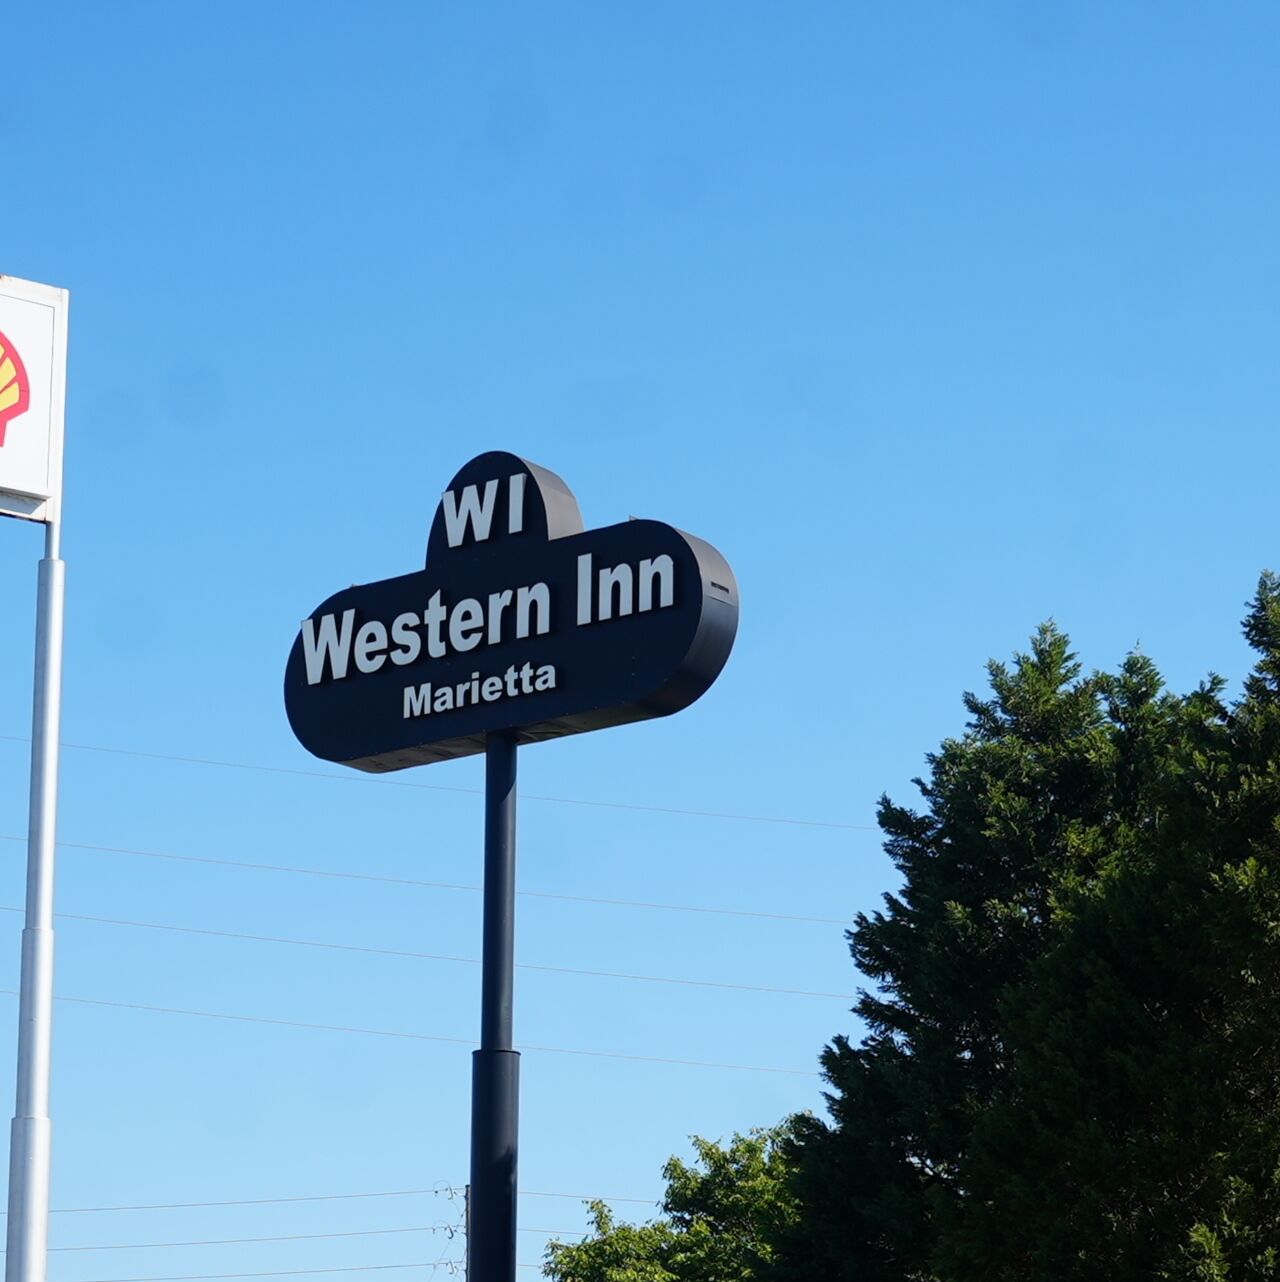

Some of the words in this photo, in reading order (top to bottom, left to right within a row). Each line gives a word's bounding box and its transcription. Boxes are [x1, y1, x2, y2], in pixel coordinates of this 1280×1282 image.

[441, 472, 528, 548] WI
[301, 581, 551, 686] Western
[577, 553, 674, 627] Inn
[403, 660, 557, 720] Marietta
